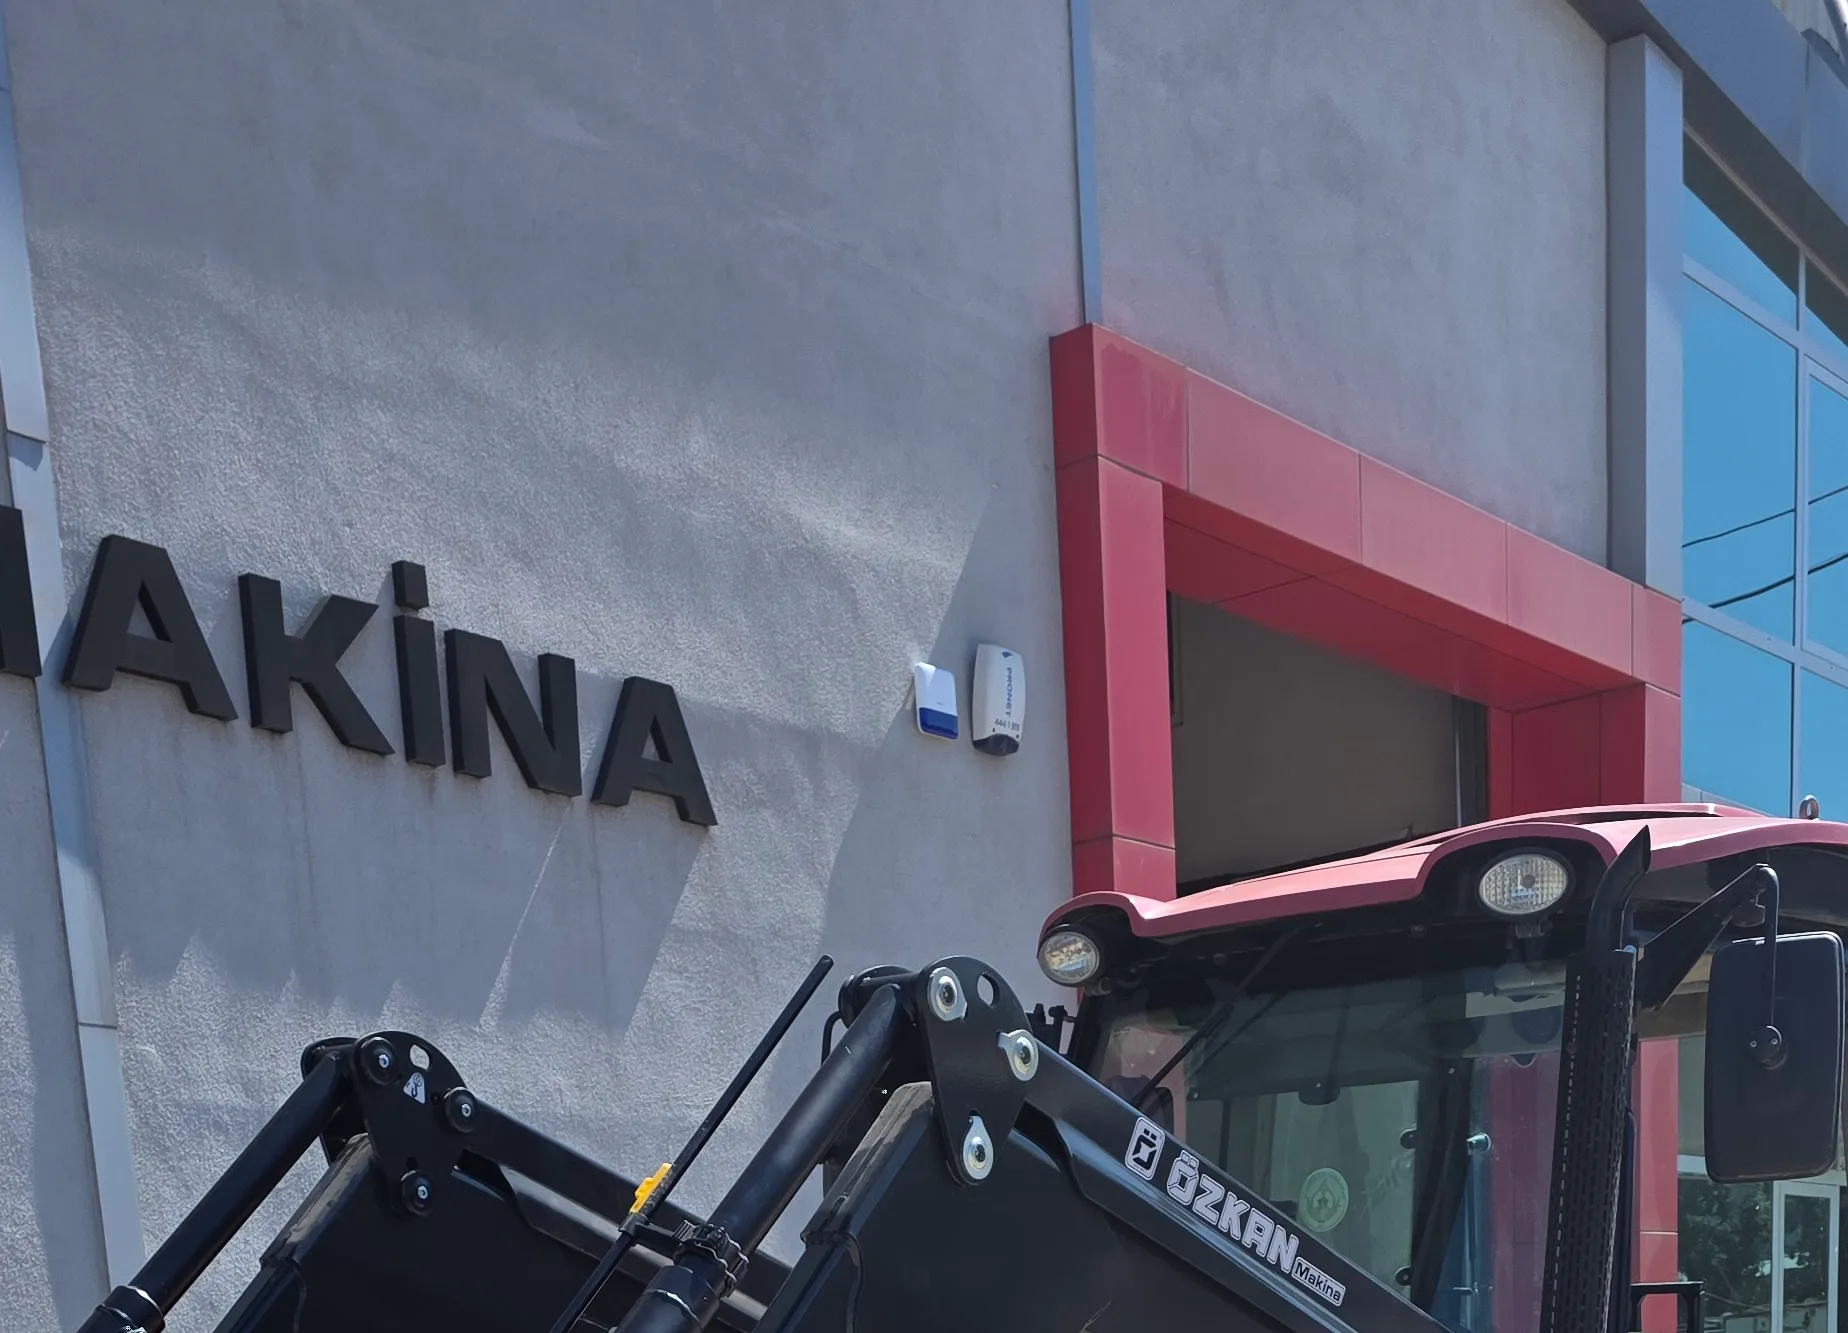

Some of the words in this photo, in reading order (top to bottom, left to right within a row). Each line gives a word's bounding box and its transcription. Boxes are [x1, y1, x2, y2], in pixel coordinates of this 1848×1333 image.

[1005, 667, 1013, 717] PRONET
[1167, 1150, 1299, 1274] ÖZKAN
[1294, 1260, 1342, 1302] Makina
